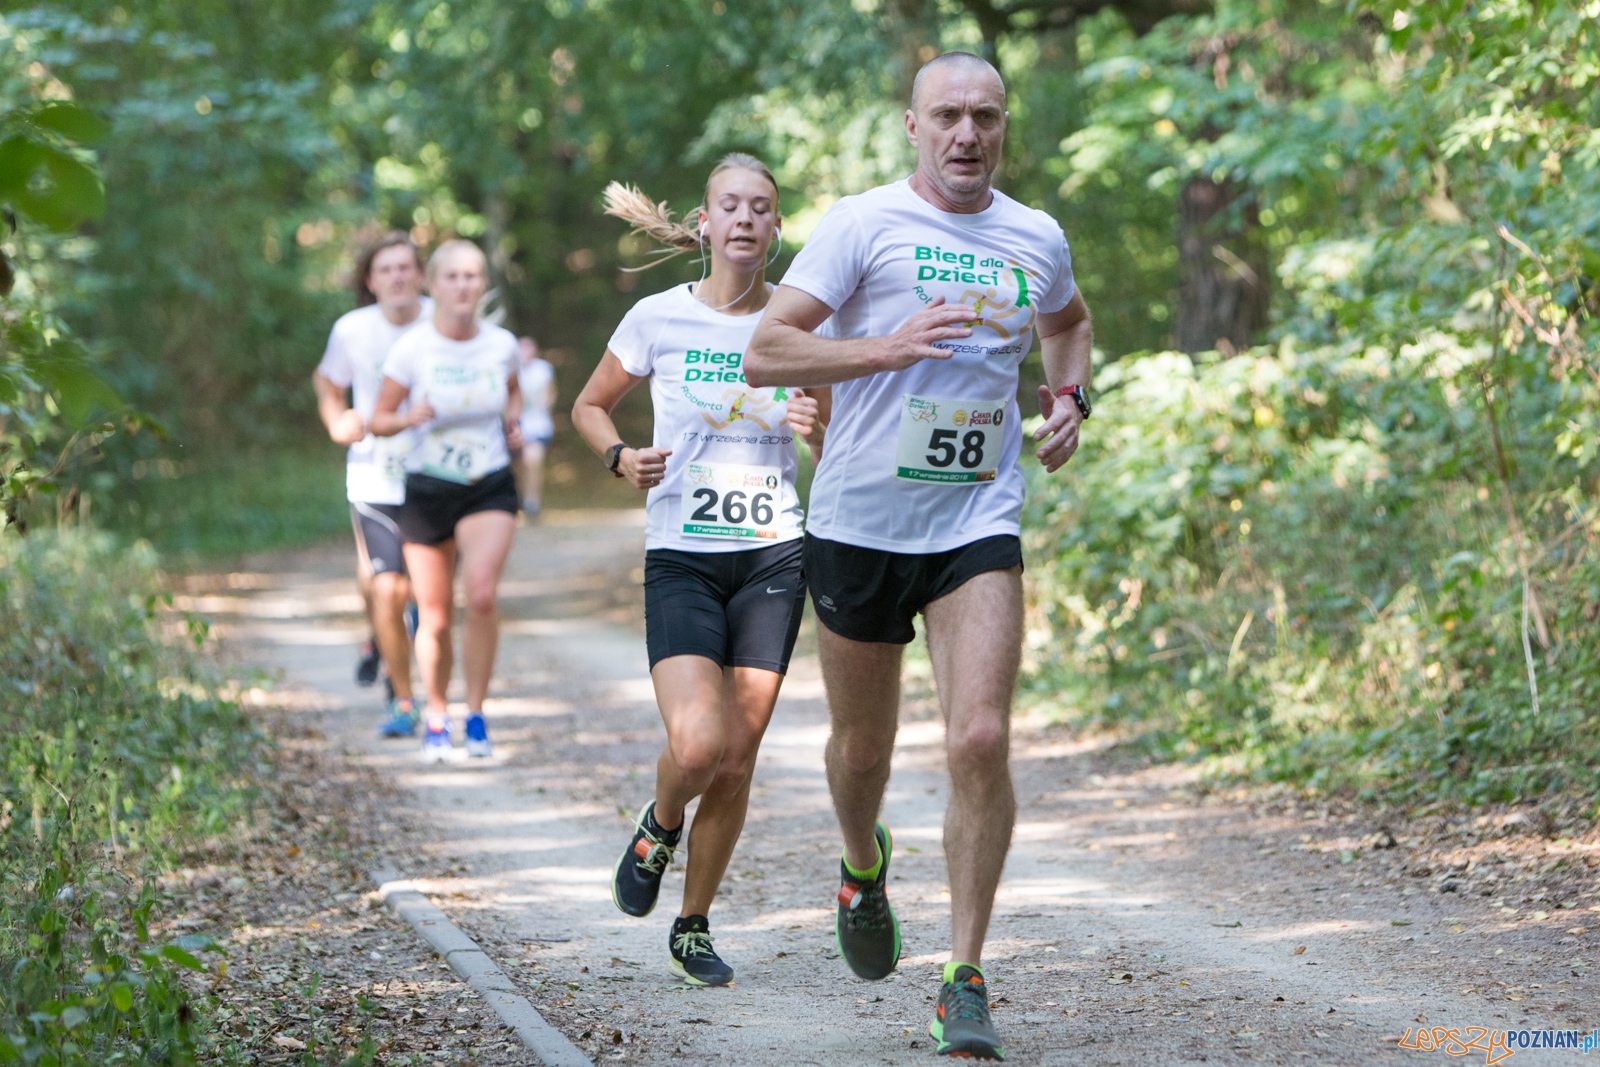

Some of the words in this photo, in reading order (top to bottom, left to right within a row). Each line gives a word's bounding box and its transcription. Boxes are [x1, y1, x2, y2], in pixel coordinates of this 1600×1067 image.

[914, 246, 975, 270] Bieg
[979, 257, 1004, 268] dla
[917, 265, 998, 286] Dzieci
[684, 347, 743, 369] Bieg
[684, 367, 748, 384] Dziec
[680, 385, 723, 411] Roberta
[682, 432, 698, 441] 17
[700, 434, 758, 445] września
[925, 428, 986, 469] 58
[440, 443, 473, 468] 76
[690, 487, 774, 526] 266
